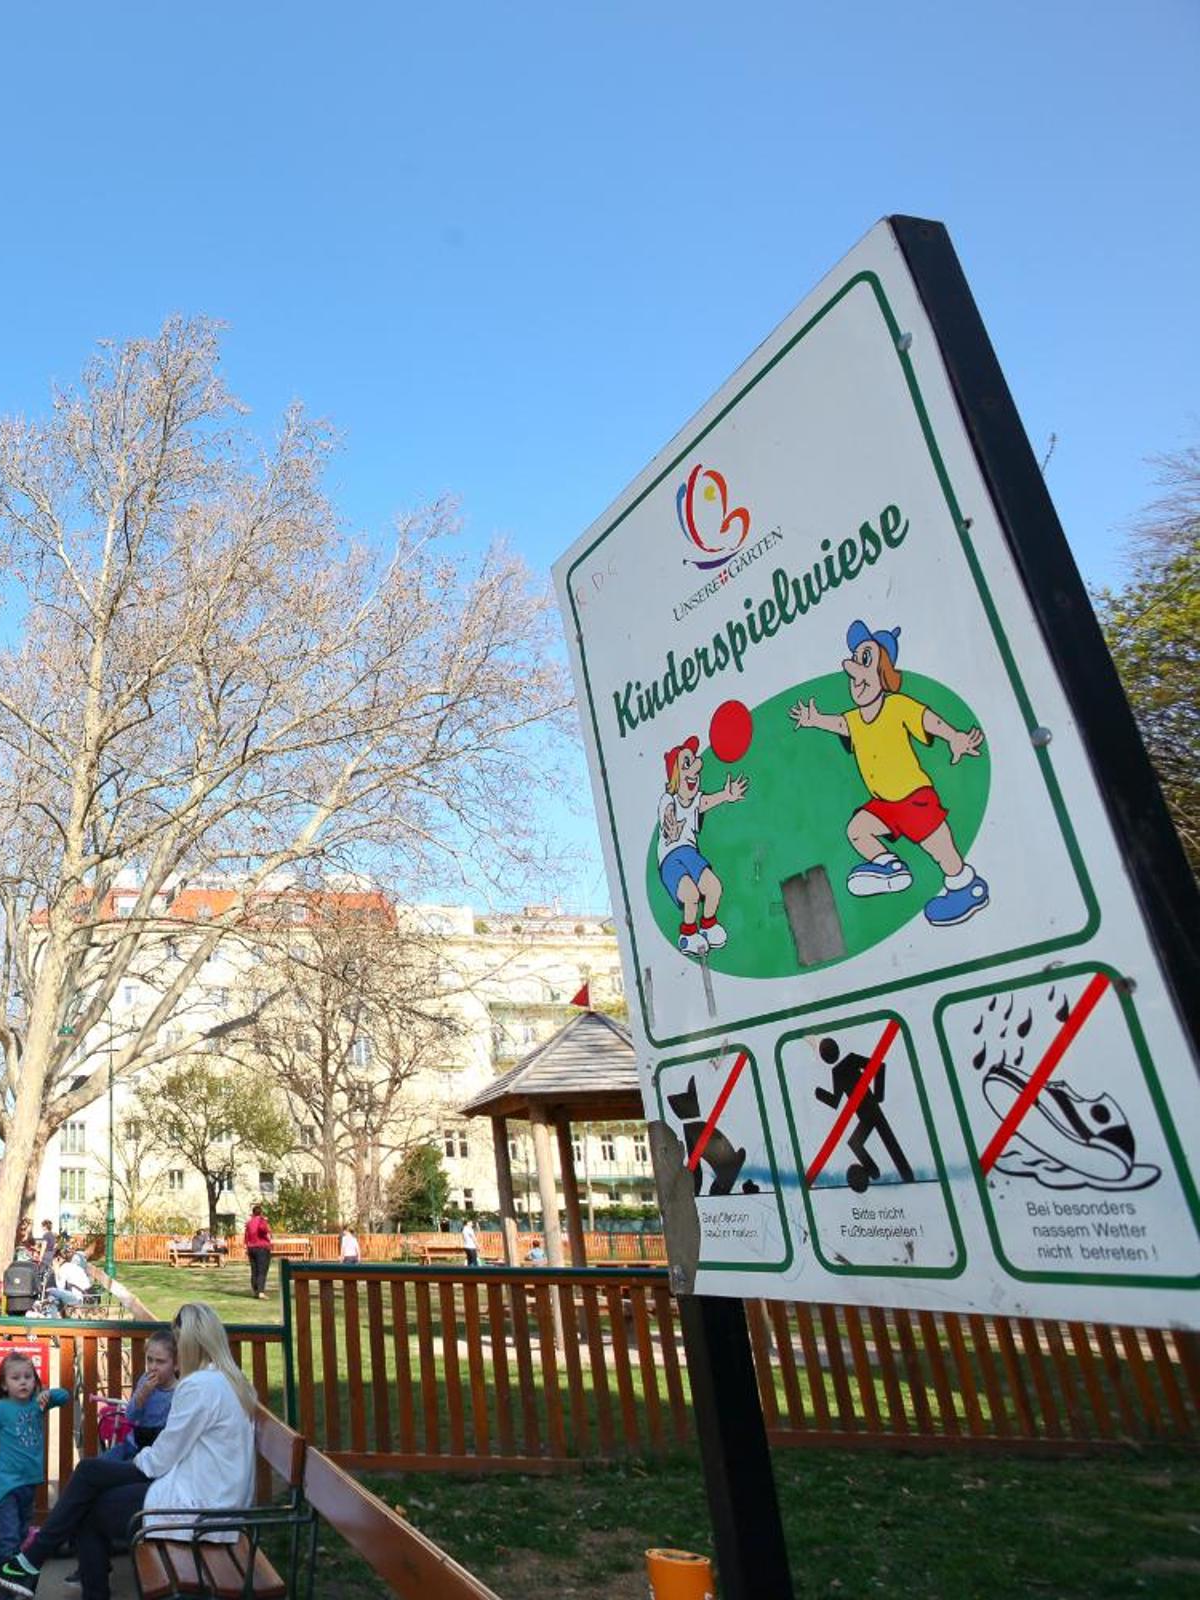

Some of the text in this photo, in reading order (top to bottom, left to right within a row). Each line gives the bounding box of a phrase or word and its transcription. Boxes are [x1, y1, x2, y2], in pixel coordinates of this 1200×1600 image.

[673, 575, 722, 622] UNSERE
[612, 504, 909, 738] Kinderspielwiese
[851, 1207, 905, 1220] Bitte nicht
[1026, 1200, 1136, 1216] Bei besonders
[1032, 1222, 1147, 1238] nassem Wetter
[1037, 1244, 1073, 1259] nicht
[1079, 1243, 1148, 1260] betreten
